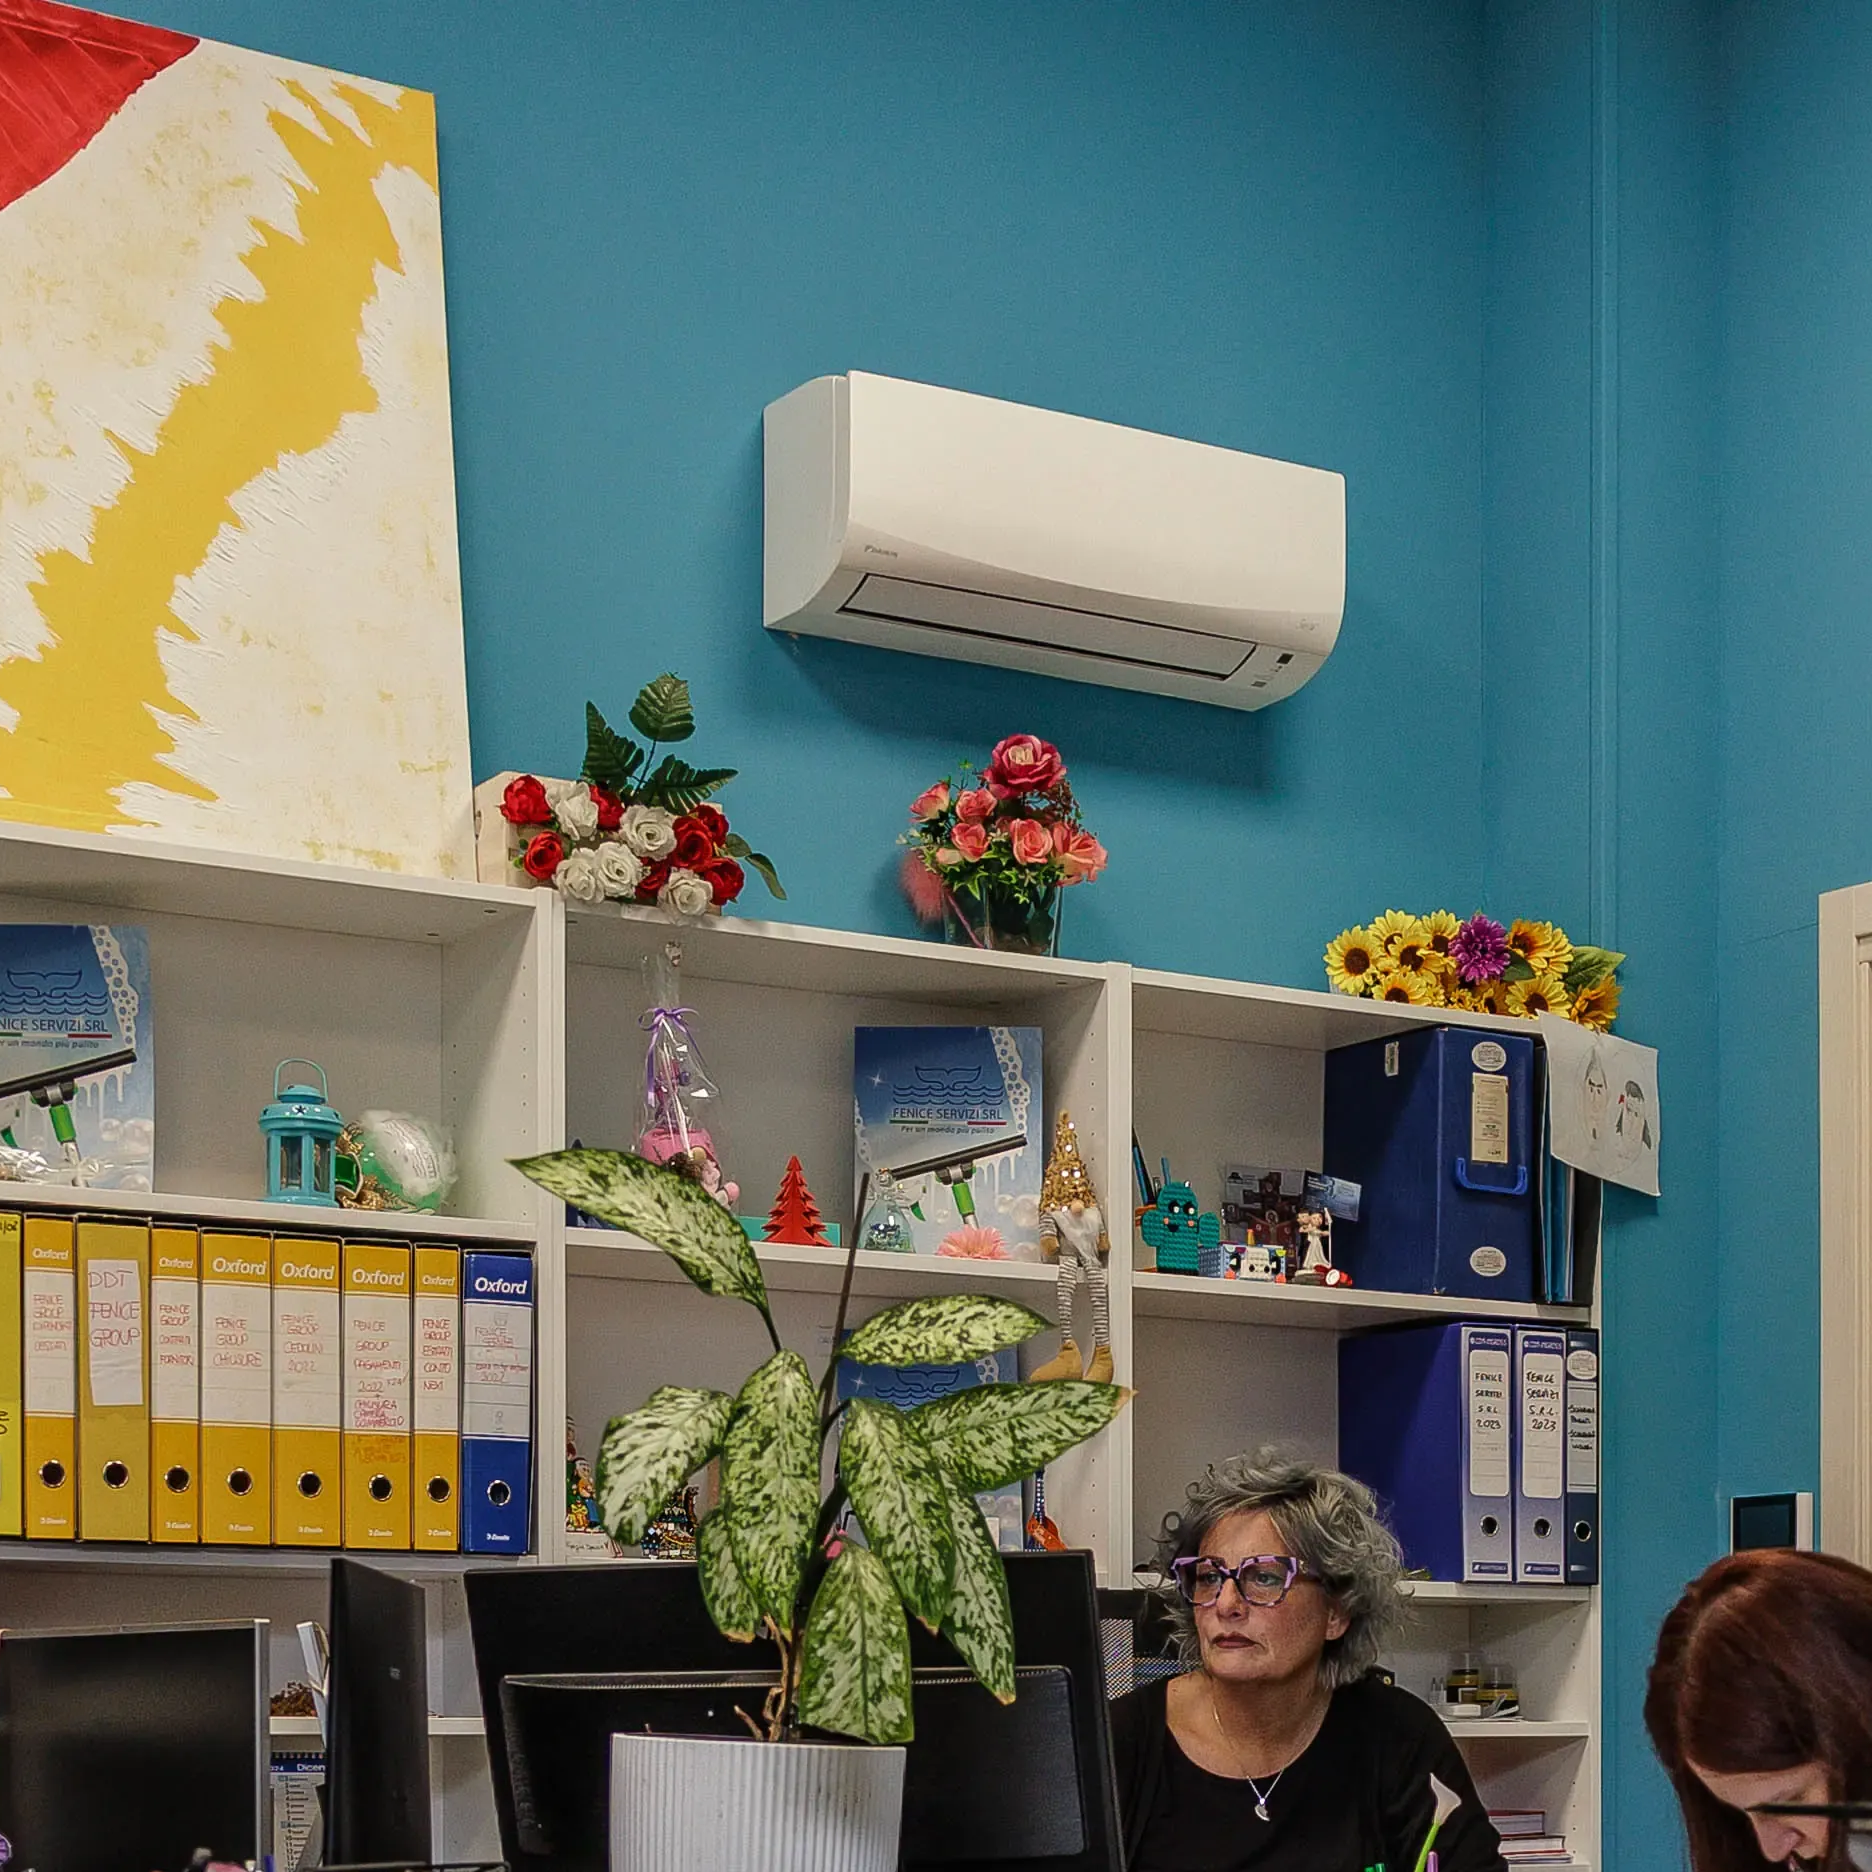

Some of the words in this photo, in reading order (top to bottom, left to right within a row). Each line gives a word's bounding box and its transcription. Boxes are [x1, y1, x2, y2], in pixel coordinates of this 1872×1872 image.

[32, 1020, 80, 1031] SERVIZI
[84, 1020, 108, 1032] SRL
[893, 1108, 932, 1119] FENICE
[936, 1109, 979, 1119] SERVIZI
[983, 1109, 1002, 1119] SRL
[32, 1248, 68, 1260] Oxford
[159, 1257, 194, 1268] Oxford
[213, 1257, 267, 1275] Oxford
[281, 1262, 335, 1279] Oxford
[352, 1268, 405, 1285] Oxford
[88, 1270, 133, 1288] DDT
[422, 1275, 455, 1286] Oxford
[475, 1277, 527, 1294] Oxford
[89, 1301, 140, 1320] FENICE
[160, 1304, 189, 1314] FENICE
[160, 1316, 189, 1326] GROUP
[216, 1317, 247, 1329] FENICE
[353, 1320, 386, 1331] FENICE
[422, 1319, 450, 1329] FENICE
[287, 1323, 319, 1335] GROUP
[90, 1328, 140, 1347] GROUP
[216, 1334, 248, 1346] GROUP
[424, 1331, 451, 1340] GROUP
[356, 1341, 390, 1351] GROUP
[1477, 1420, 1501, 1429] 2023
[1532, 1419, 1556, 1431] 2023
